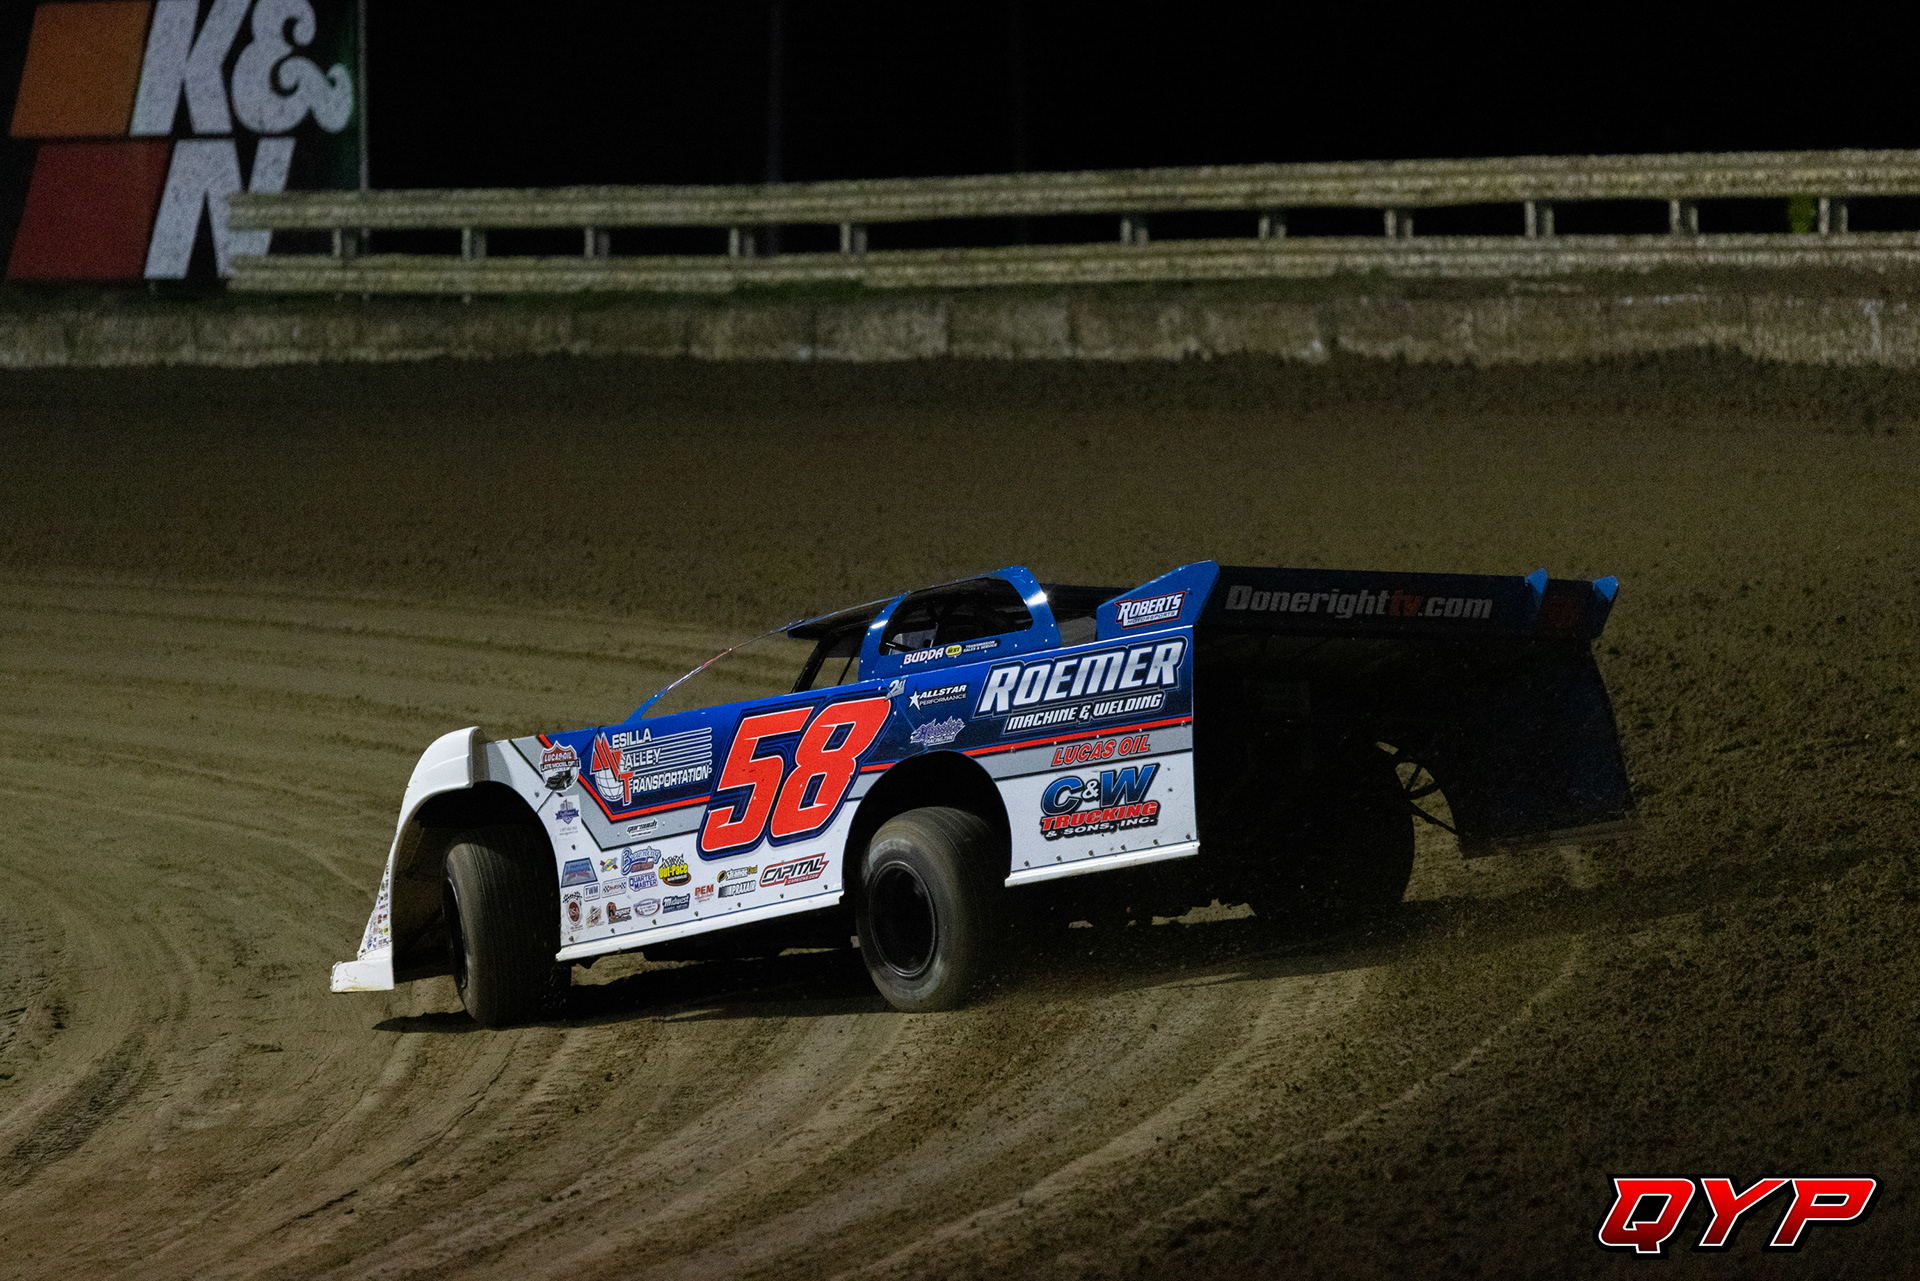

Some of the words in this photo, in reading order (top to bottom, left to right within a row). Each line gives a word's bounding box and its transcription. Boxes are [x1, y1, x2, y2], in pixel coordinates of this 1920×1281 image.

[1117, 593, 1183, 624] ROBERTS
[1225, 585, 1493, 618] Donerighttv.com
[904, 647, 944, 665] BUDDA
[977, 640, 1184, 713] ROEMER
[919, 685, 967, 699] ALLSTAR
[920, 693, 967, 706] PERFORMANCE
[1007, 708, 1076, 730] MACHINE
[1079, 705, 1091, 720] &
[1092, 694, 1163, 717] WELDING
[544, 753, 563, 763] LUCAS
[1052, 740, 1115, 767] LUCAS
[1119, 735, 1150, 757] OIL
[699, 694, 893, 854] 58
[1041, 763, 1158, 815] C&W
[1041, 801, 1159, 831] TRUCKING
[1045, 829, 1058, 838] &
[1120, 817, 1155, 828] INC.
[629, 875, 656, 887] QUARTER
[762, 858, 822, 883] CAPITAL
[634, 880, 658, 891] MASTER
[694, 884, 714, 896] PEM
[731, 880, 757, 896] PRAXAIR
